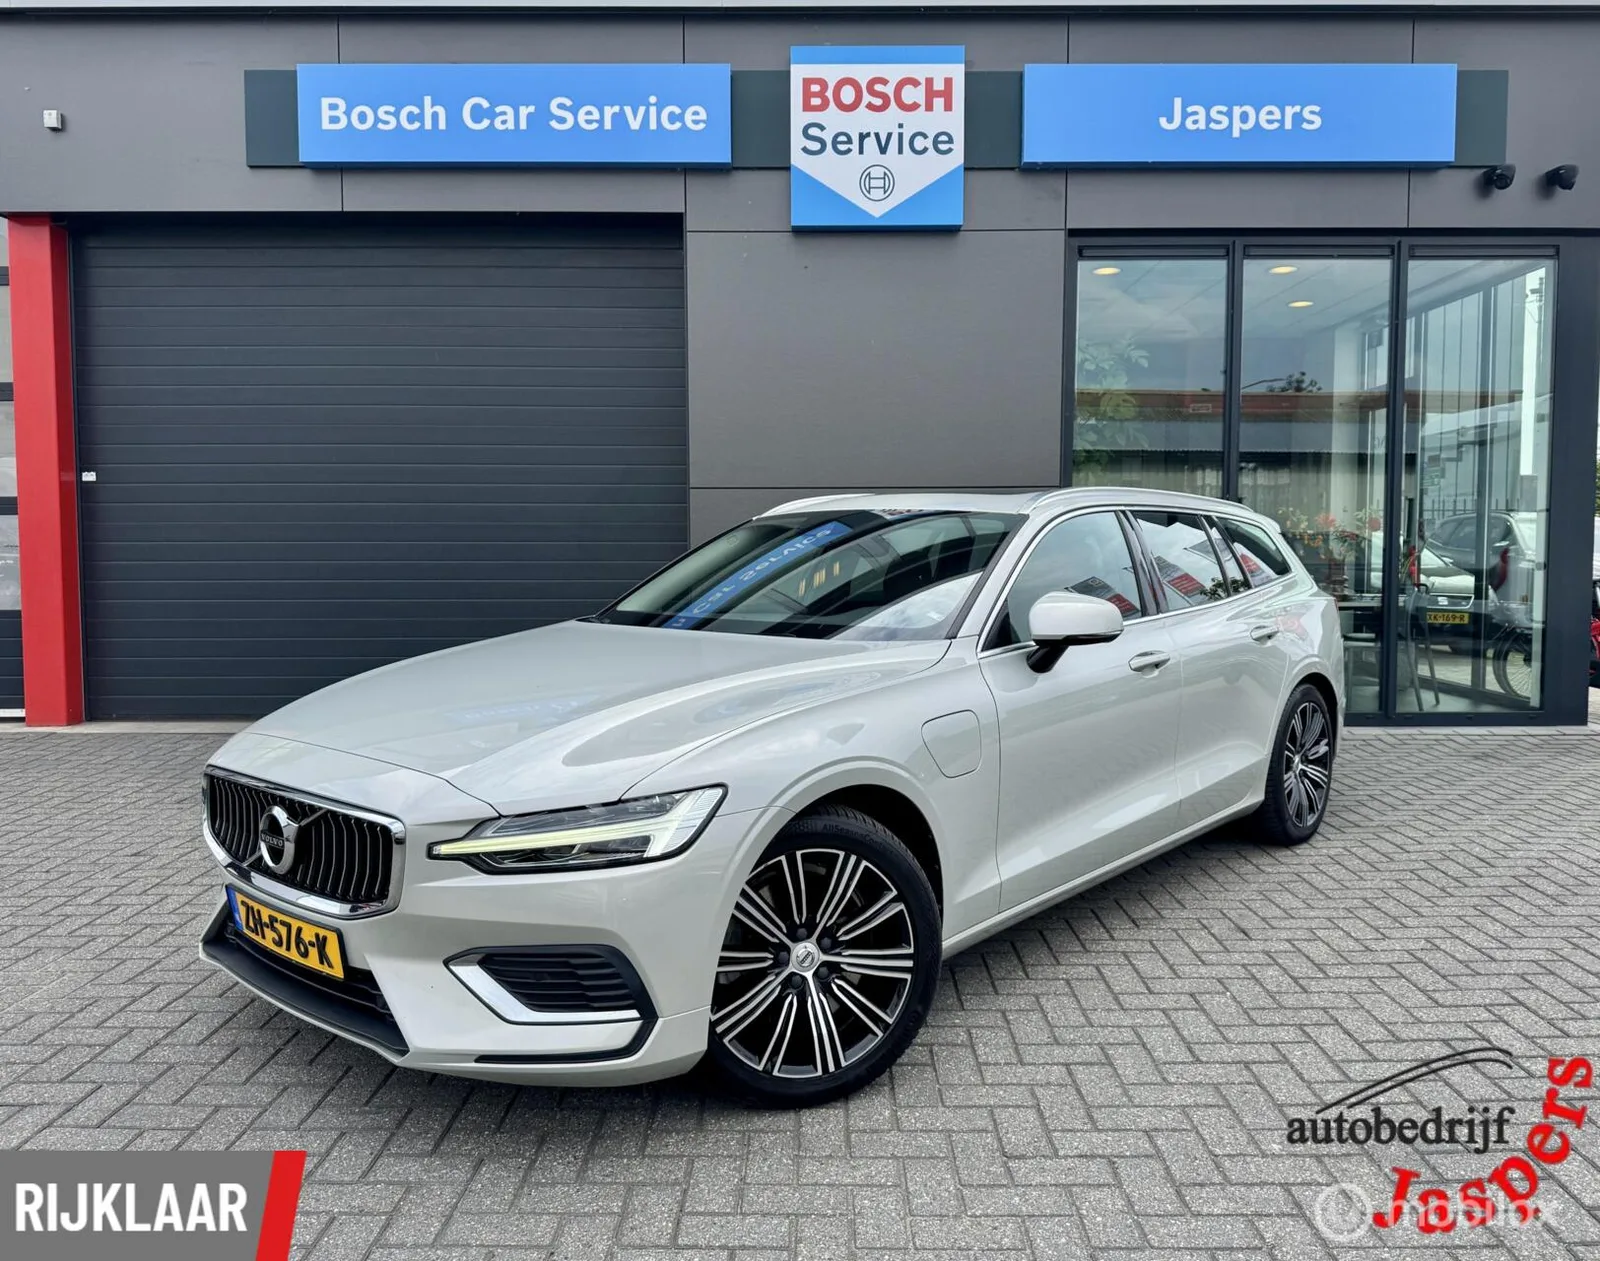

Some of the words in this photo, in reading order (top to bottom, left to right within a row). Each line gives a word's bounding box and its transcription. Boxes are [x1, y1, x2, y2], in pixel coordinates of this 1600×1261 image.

[320, 96, 447, 131] Bosch
[461, 96, 536, 131] Car
[548, 95, 708, 131] Service
[802, 77, 953, 113] BOSCH
[1158, 96, 1323, 138] Jaspers
[800, 122, 955, 156] Service
[261, 832, 284, 847] VOLVO
[240, 900, 335, 969] ZH-576-K
